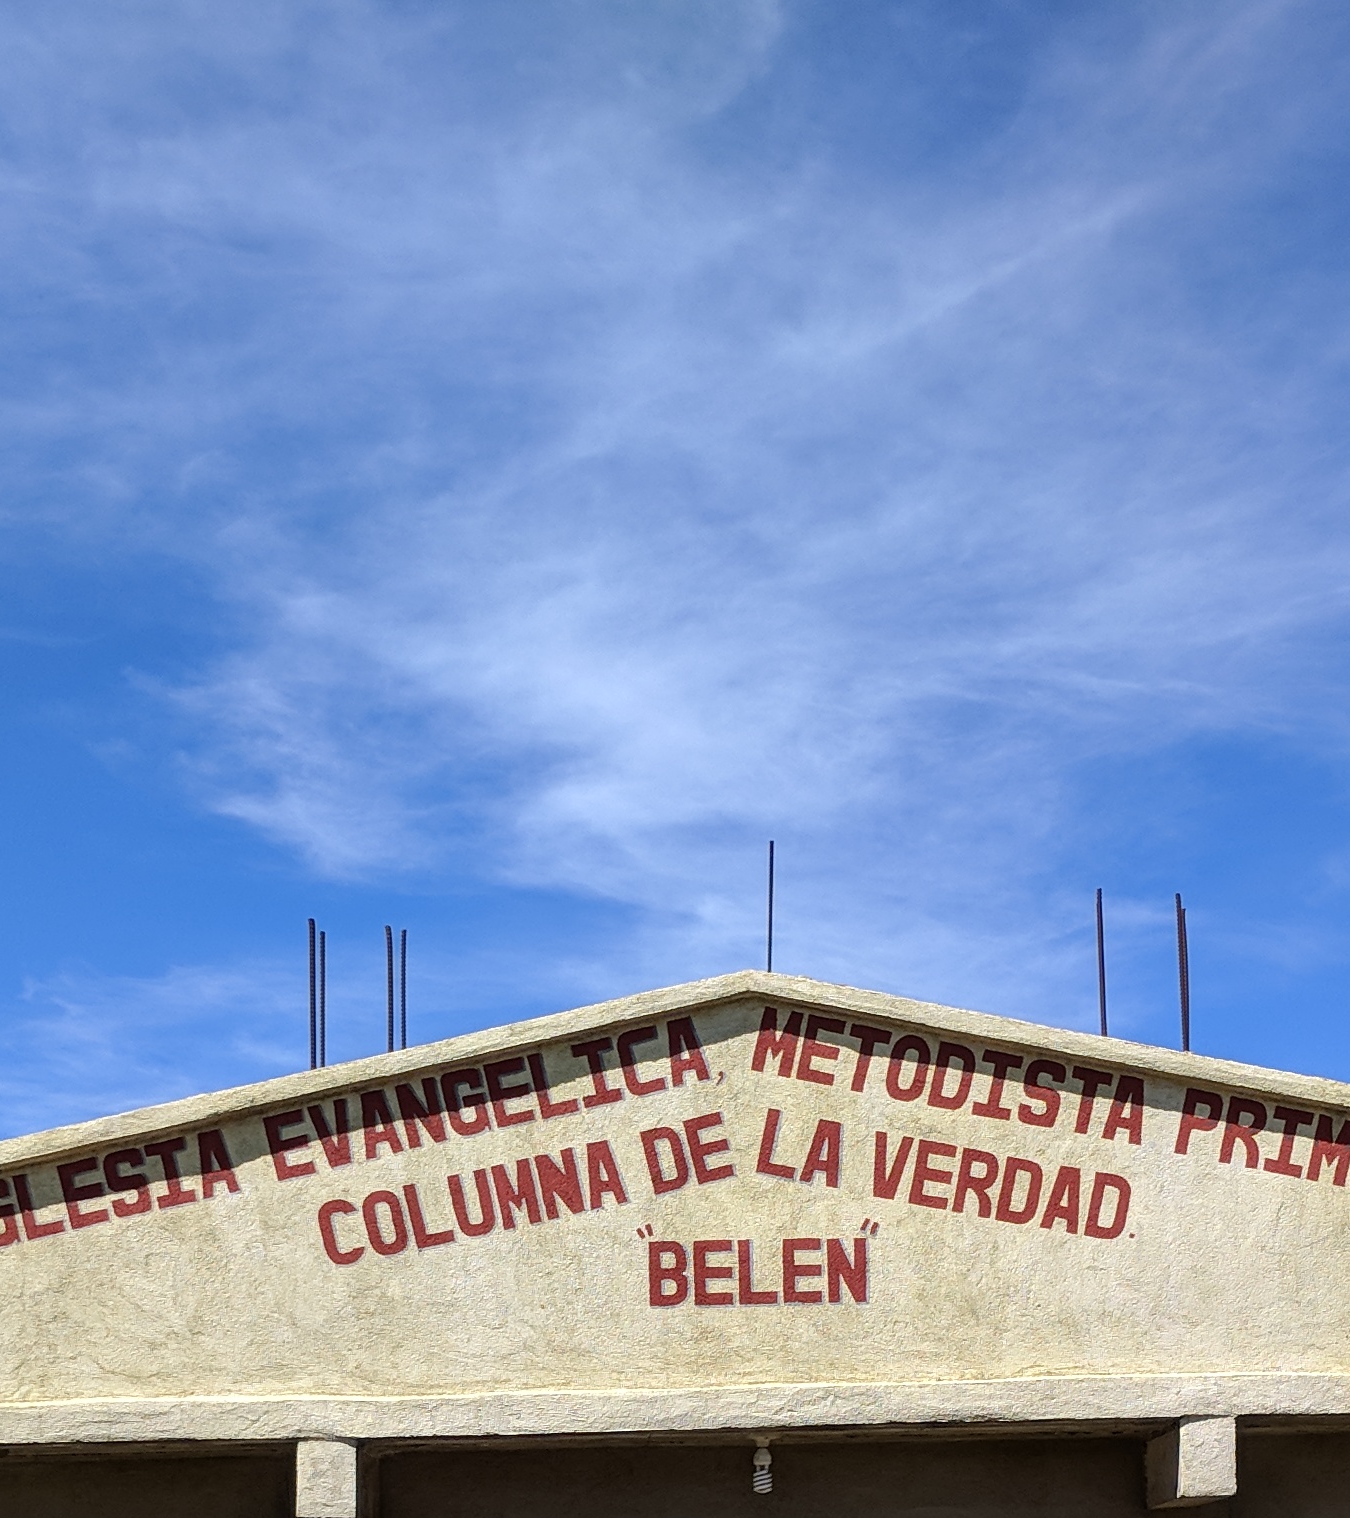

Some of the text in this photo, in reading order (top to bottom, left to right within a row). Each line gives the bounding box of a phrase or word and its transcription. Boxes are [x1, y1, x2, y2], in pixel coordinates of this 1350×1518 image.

[264, 1016, 726, 1182] EVANGELICA,
[751, 1006, 1145, 1146] METODISTA
[317, 1108, 1136, 1265] COLUMNA DE LA VERDAD.
[636, 1217, 879, 1307] "BELEN"
